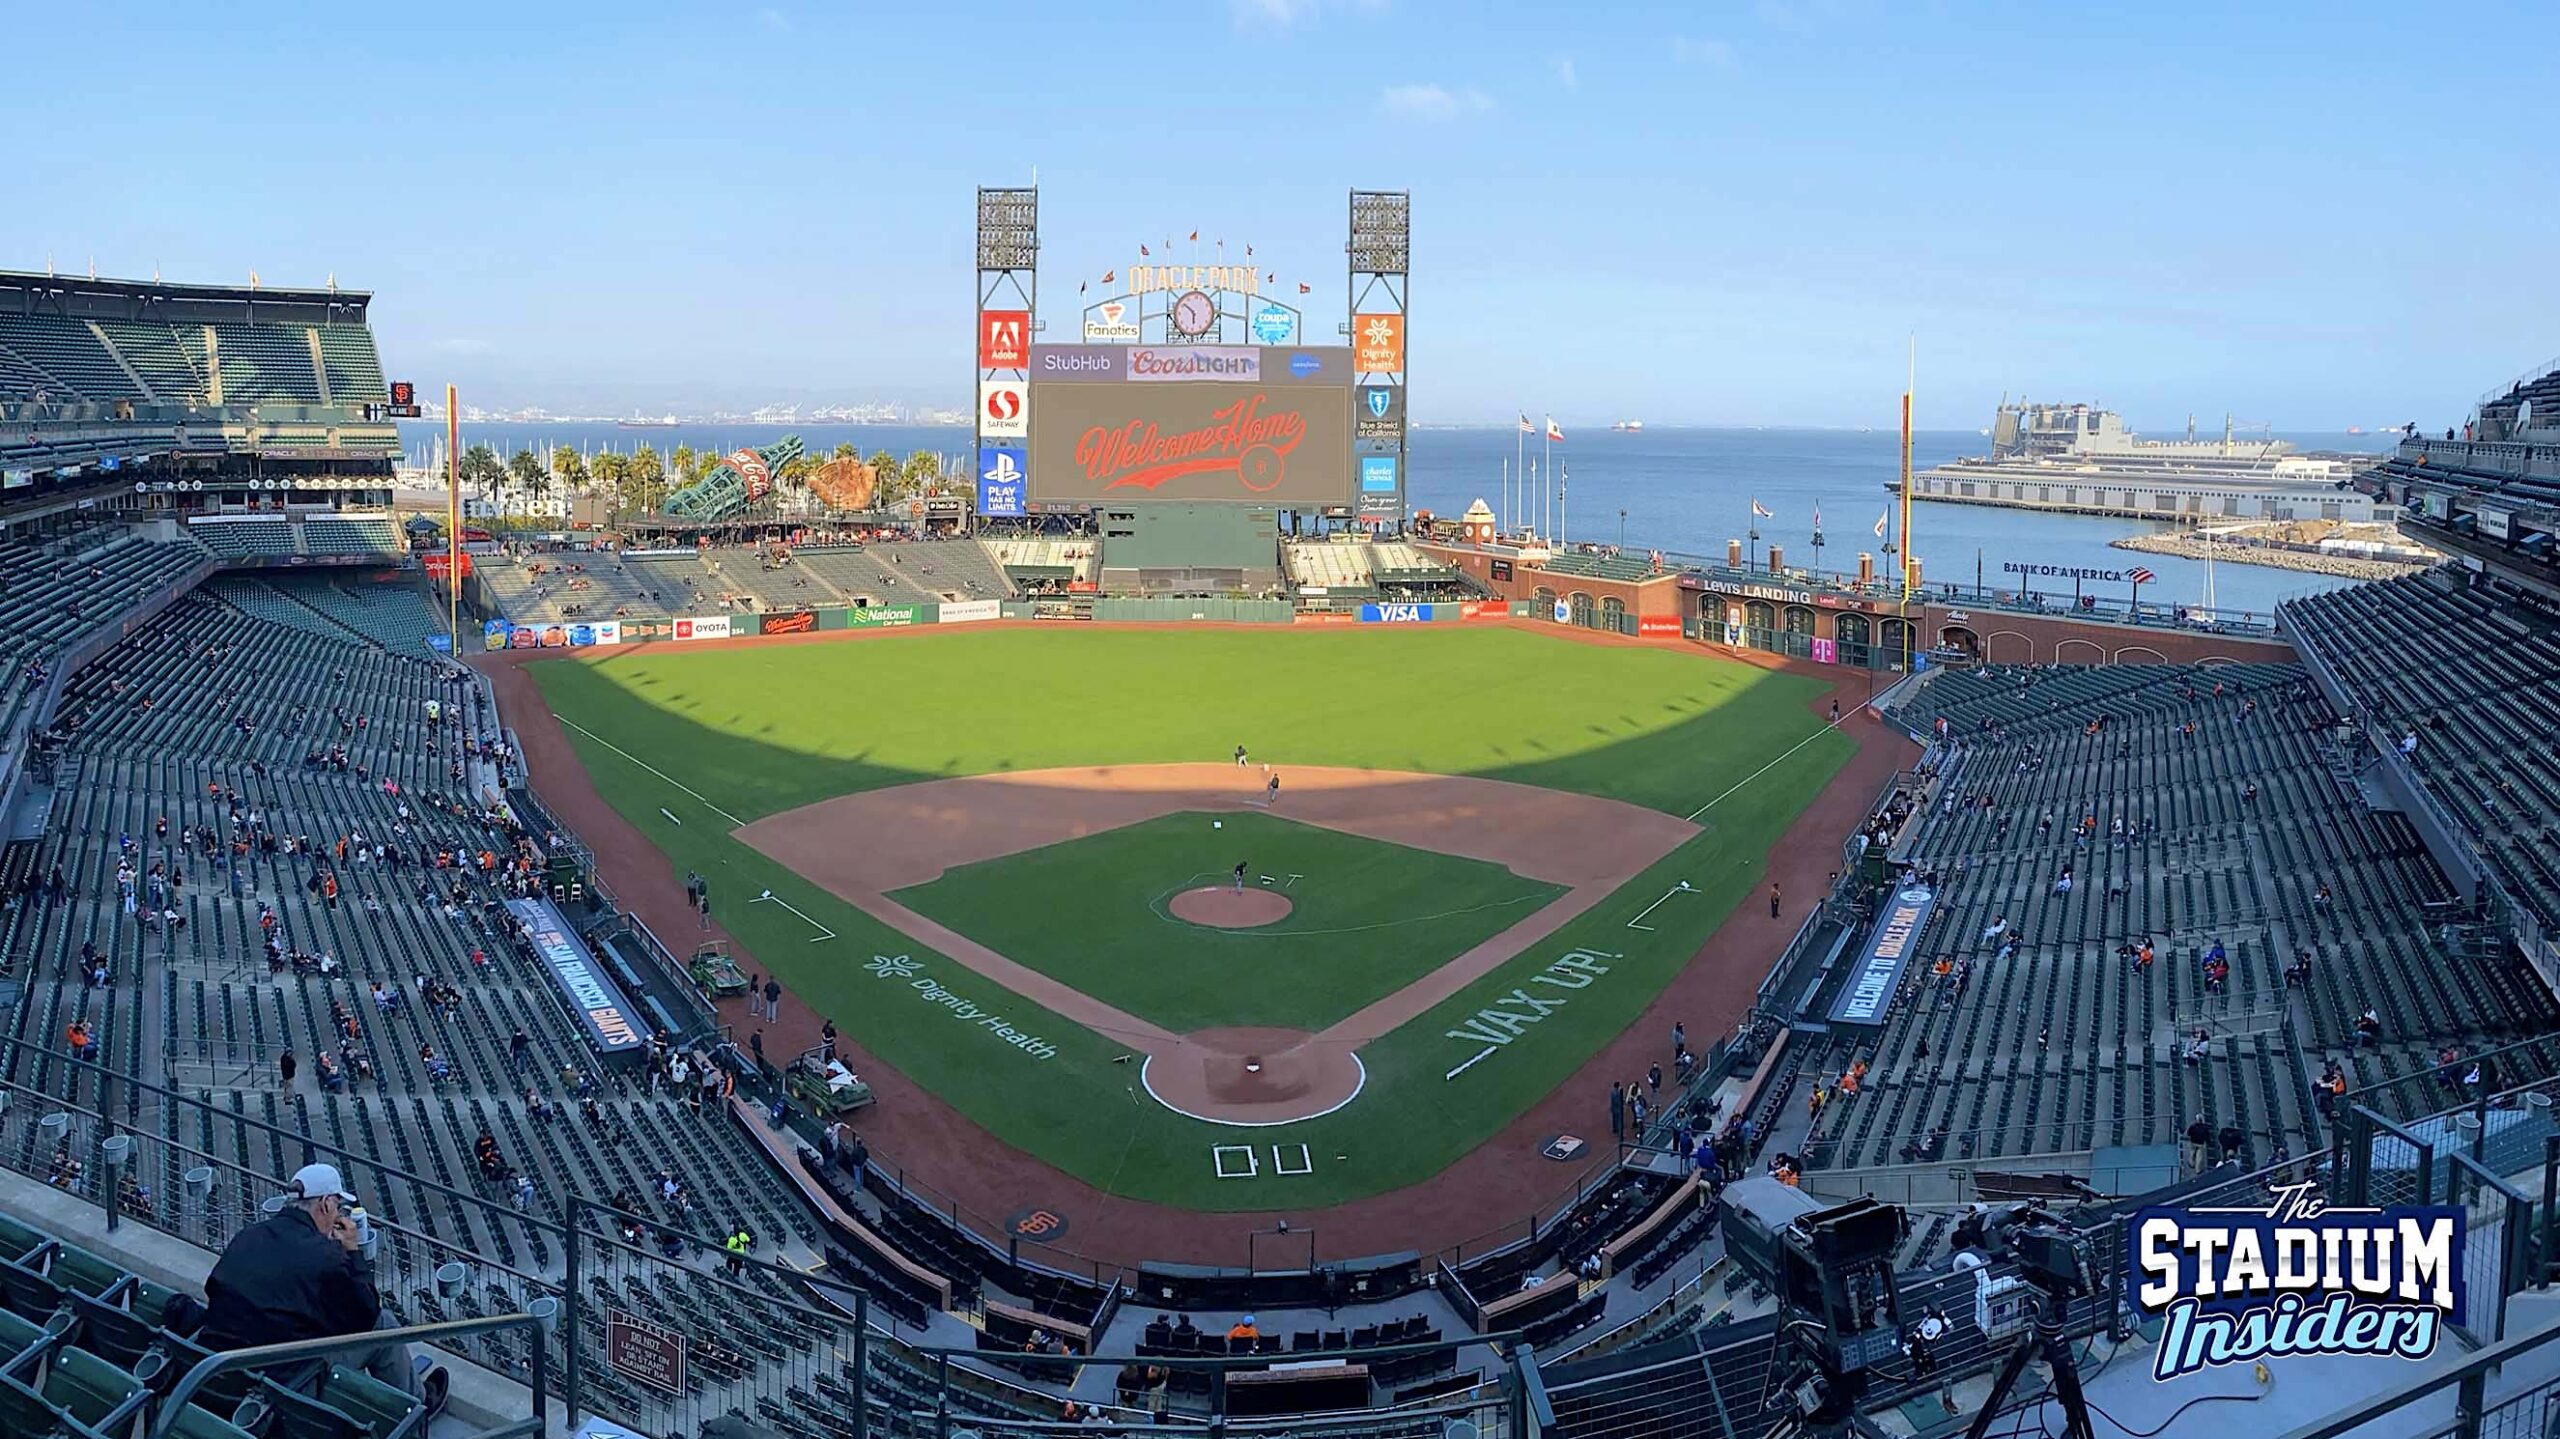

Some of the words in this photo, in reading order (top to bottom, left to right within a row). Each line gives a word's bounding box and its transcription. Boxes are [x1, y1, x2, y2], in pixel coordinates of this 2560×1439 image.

[1129, 267, 1204, 295] ORACLE
[1208, 267, 1260, 295] PARK
[1087, 324, 1138, 336] Fanatics
[992, 350, 1018, 360] Adobe
[1044, 355, 1111, 370] StubHub
[1134, 351, 1196, 374] Coors
[1196, 357, 1250, 375] LIGHT
[1362, 349, 1396, 361] Dignity
[1363, 360, 1395, 369] Health
[1075, 419, 1216, 480] Welcome
[1212, 393, 1301, 451] Home
[988, 487, 1015, 496] PLAY
[988, 503, 1016, 511] LIMITS
[2003, 562, 2039, 575] BANK
[2041, 566, 2059, 577] OF
[2060, 567, 2122, 582] AMERICA
[1744, 585, 1811, 604] LANDING
[868, 607, 914, 621] National
[1376, 606, 1420, 622] VISA
[1889, 906, 1921, 927] PARK
[1874, 925, 1913, 959] ORACLE
[545, 944, 578, 963] SAN
[1867, 958, 1897, 971] TO
[556, 960, 612, 1009] FRANCISCO
[1445, 989, 1568, 1045] VAX
[1530, 947, 1623, 989] UP!
[1844, 971, 1892, 1018] WELCOME
[588, 1008, 639, 1045] GIANTS
[911, 979, 987, 1019] Dignity
[978, 1017, 1056, 1060] Health
[622, 1313, 669, 1340] PLEASE
[631, 1331, 641, 1343] DO
[643, 1337, 661, 1351] NOT
[620, 1356, 652, 1374] AGAINST
[626, 1351, 636, 1360] OR
[638, 1356, 665, 1371] STAND
[644, 1350, 657, 1360] SIT
[659, 1356, 670, 1366] ON
